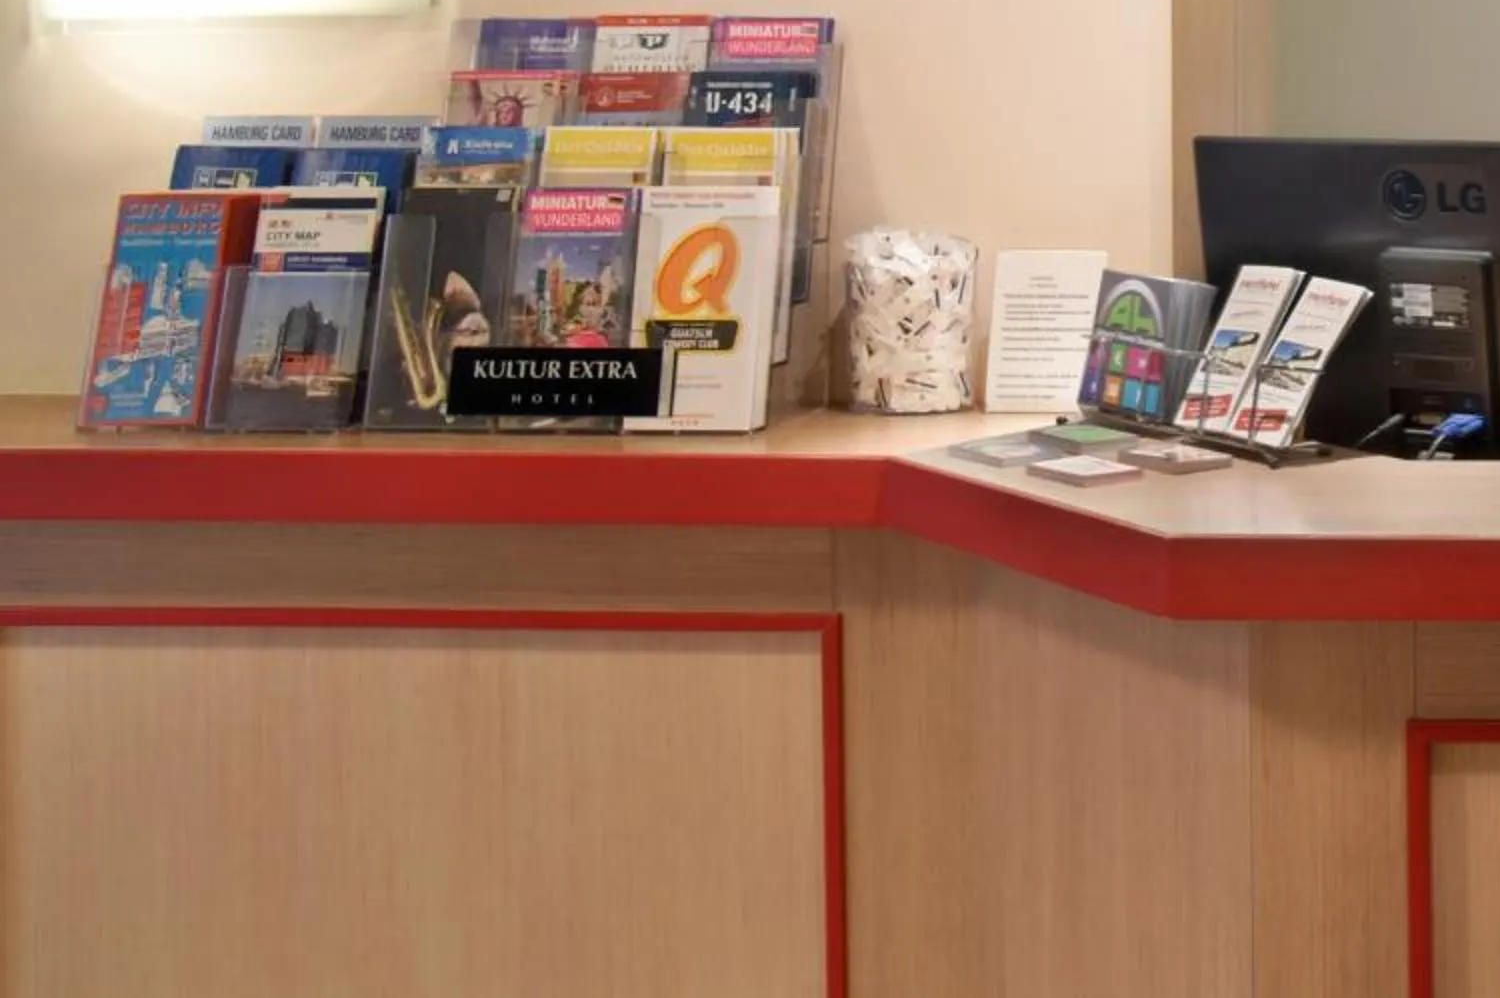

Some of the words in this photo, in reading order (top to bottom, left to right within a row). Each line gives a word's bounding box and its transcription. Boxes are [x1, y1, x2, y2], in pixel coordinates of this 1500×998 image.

[211, 124, 270, 141] HAMBURG
[271, 124, 303, 140] CARD
[330, 125, 388, 142] HAMBURG
[389, 125, 421, 142] CARD
[531, 194, 606, 210] MINIATUR
[1436, 181, 1487, 214] LG
[265, 230, 292, 242] CITY
[294, 230, 322, 242] MAP
[473, 358, 562, 380] KULTUR
[567, 359, 638, 380] EXTRA
